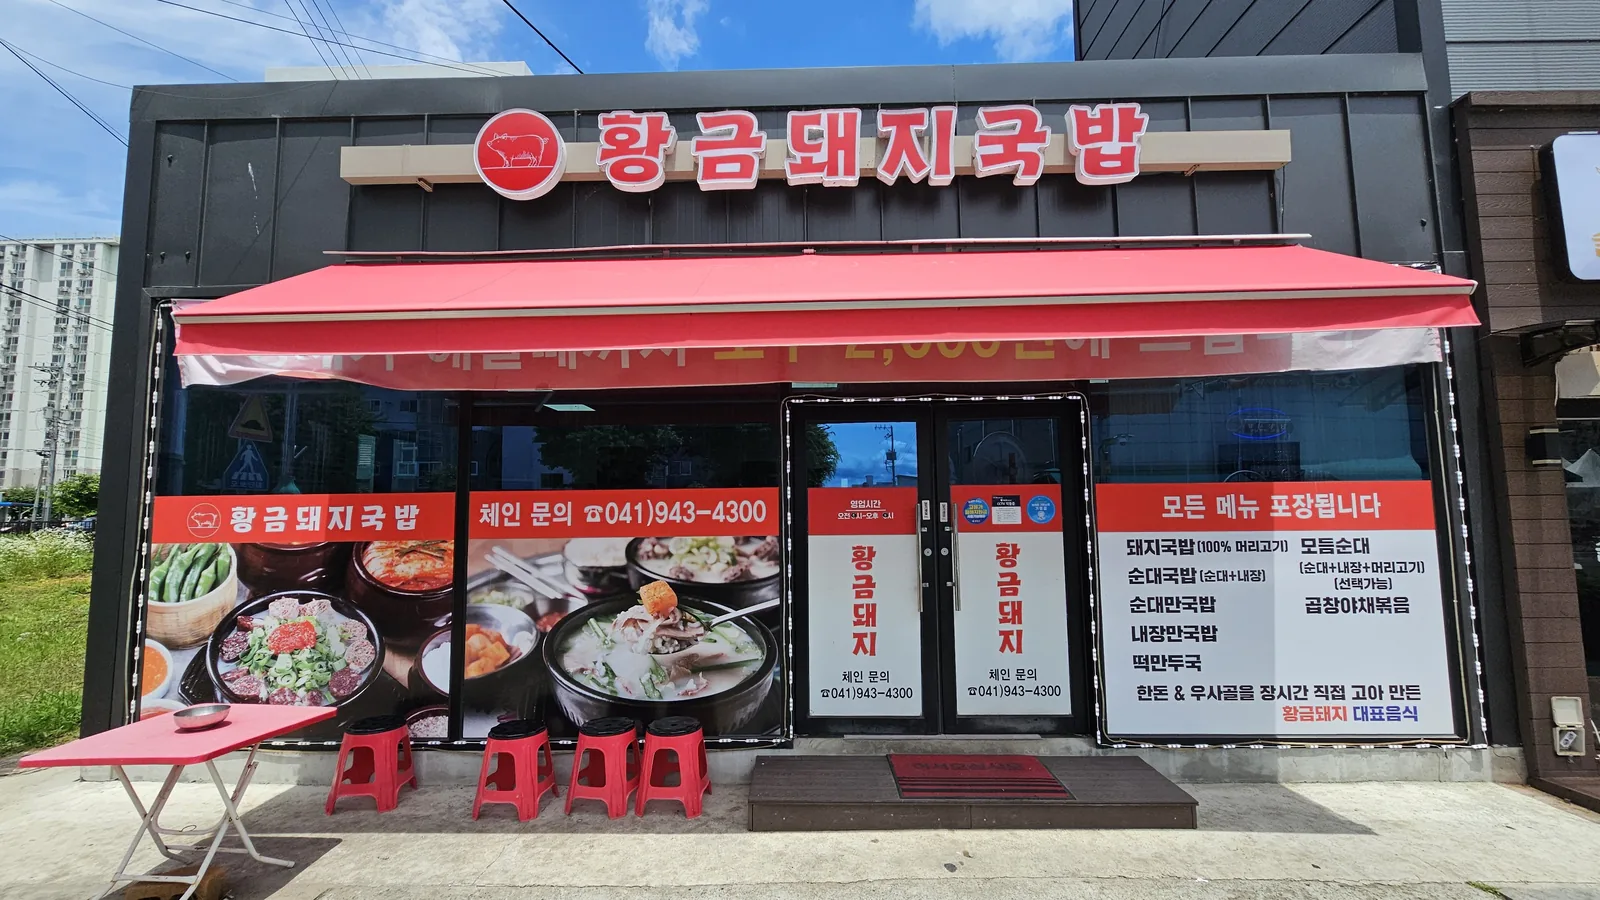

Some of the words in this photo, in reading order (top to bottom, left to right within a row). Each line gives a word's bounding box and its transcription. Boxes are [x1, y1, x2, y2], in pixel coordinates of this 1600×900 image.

[598, 103, 1148, 192] 황금돼지국밥
[479, 502, 521, 527] 체인
[530, 501, 572, 526] 문의
[605, 499, 767, 527] 041)943-4300
[850, 499, 882, 509] 영업시간
[1162, 495, 1206, 519] 모든
[1216, 494, 1260, 519] 메뉴
[1270, 493, 1381, 519] 포장됩니다
[230, 504, 420, 533] 황금돼지국밥
[1127, 538, 1195, 556] 돼지국밥
[1197, 540, 1232, 554] (100%
[1235, 539, 1288, 554] 머리고기)
[1301, 537, 1370, 555] 모듬순대
[1128, 567, 1197, 584] 순대국밥
[1200, 569, 1266, 583] (순대+내장)
[1299, 561, 1425, 575] (순대+내장+머리고기)
[1334, 577, 1393, 590] (선택가능)
[851, 545, 877, 657] 황금돼지
[995, 542, 1023, 654] 황금돼지
[1130, 596, 1216, 614] 순대만국밥
[1305, 596, 1410, 614] 곱창야채볶음
[1131, 625, 1218, 643] 내장만국밥
[1133, 654, 1202, 672] 떡만두국
[842, 670, 863, 683] 체인
[868, 670, 890, 683] 문의
[989, 668, 1011, 681] 체인
[1015, 668, 1037, 681] 문의
[831, 686, 913, 700] 041)943-4300
[978, 684, 1061, 698] 041)943-4300
[1136, 684, 1168, 701] 한돈
[1174, 687, 1185, 700] &
[1190, 685, 1255, 701] 우사골을
[1260, 685, 1309, 701] 장시간
[1314, 685, 1345, 701] 직접
[1351, 685, 1384, 700] 고아
[1389, 685, 1421, 700] 만든
[1282, 705, 1348, 722] 황금돼지
[1353, 705, 1418, 722] 대표음식
